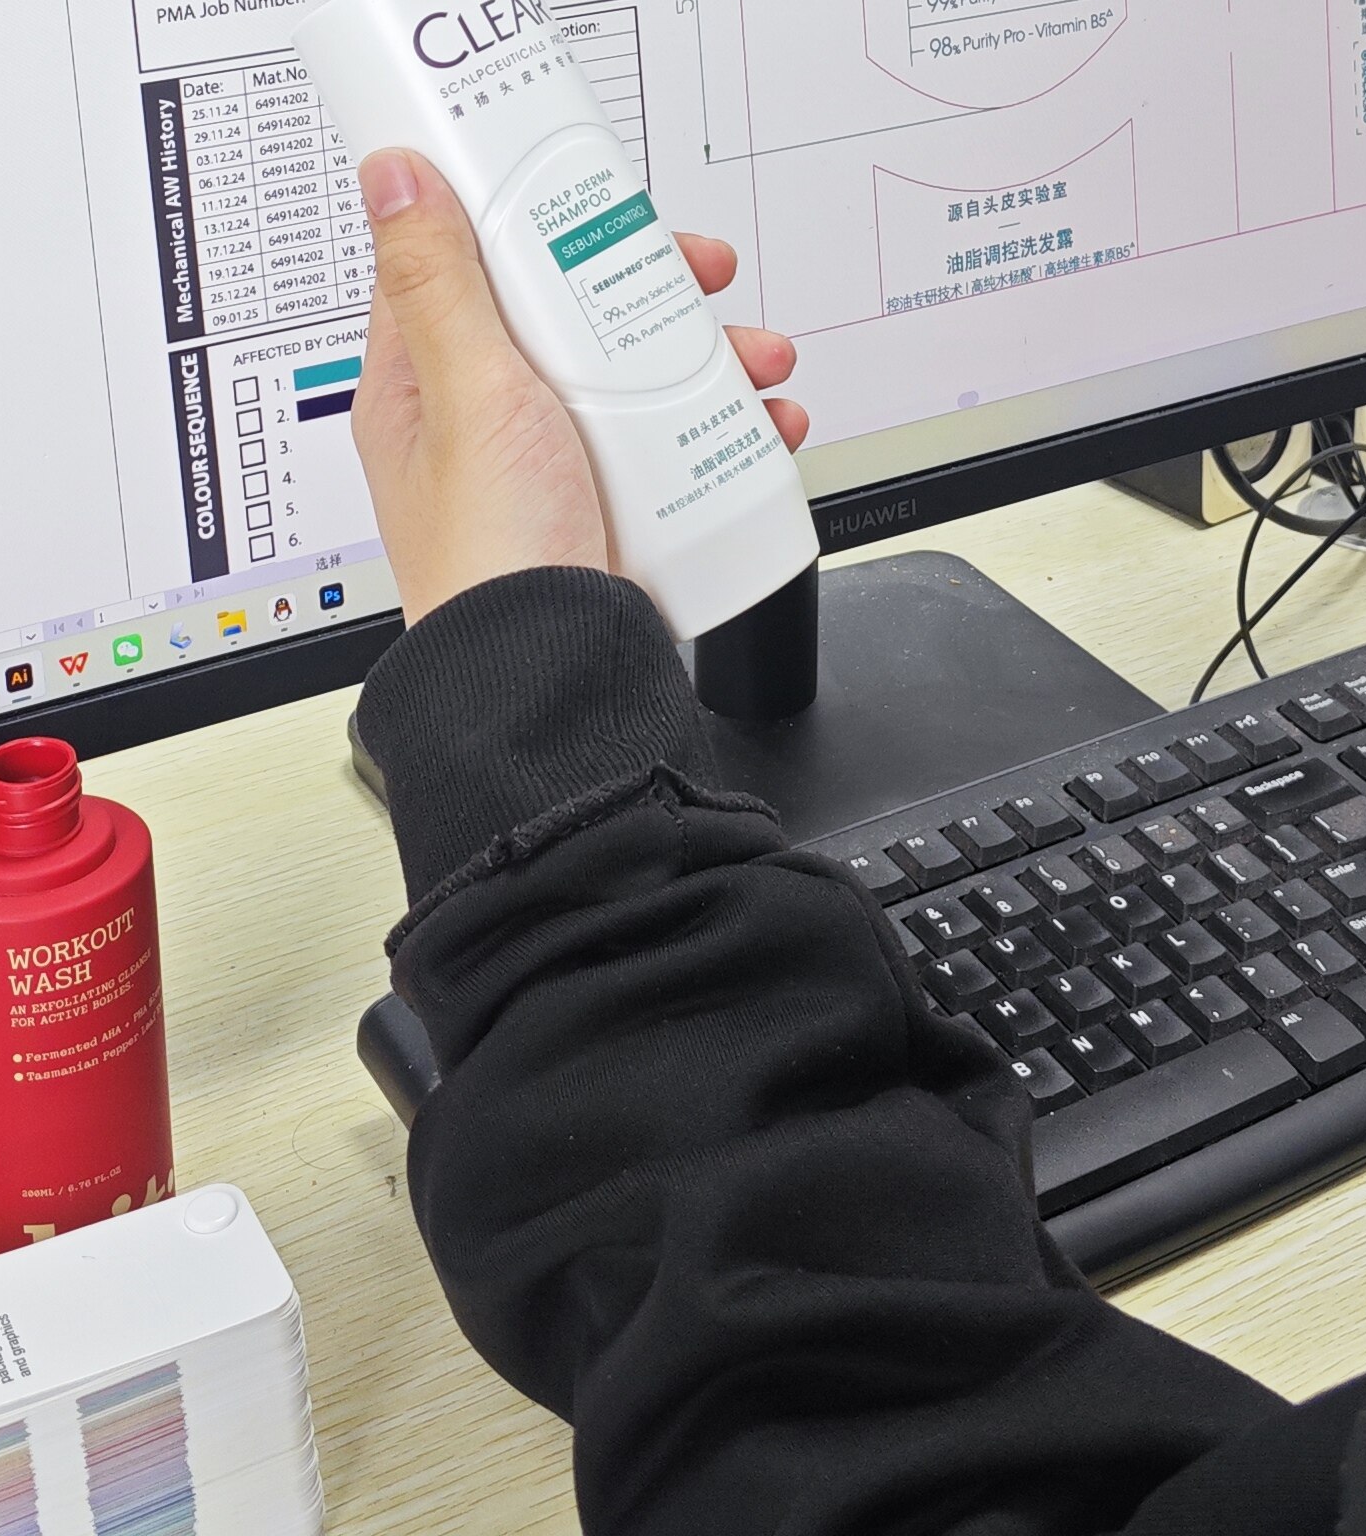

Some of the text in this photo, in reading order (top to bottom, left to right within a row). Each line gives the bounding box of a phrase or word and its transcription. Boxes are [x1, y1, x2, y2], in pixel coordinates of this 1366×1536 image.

[156, 3, 197, 25] PMA
[200, 0, 230, 19] Job
[963, 15, 1087, 52] Purity Vitamin
[439, 40, 547, 100] SCALPCEUTICALS
[183, 81, 225, 99] Date:
[255, 91, 310, 110] 64914202
[191, 103, 239, 121] 25.11.24
[198, 172, 246, 190] 06.12.24
[262, 159, 316, 179] 64914202
[528, 167, 615, 222] SCALP DERMA
[947, 180, 1068, 223] 源自头皮实验室
[158, 98, 194, 324] Mechanical AW History
[536, 187, 612, 237] SHAMPOO
[268, 227, 322, 247] 64914202
[560, 202, 649, 260] SEBUM CONTROL
[206, 240, 253, 259] 17.12.24
[946, 227, 1074, 275] 油脂调控洗发露
[212, 308, 260, 327] 09.01.25
[275, 294, 329, 314] 64914202
[233, 338, 323, 366] AFFECTED BY
[180, 352, 216, 540] COLOUR SEQUENCE
[828, 498, 918, 538] HUAWEI
[324, 590, 341, 604] Ps
[11, 669, 28, 686] Ai
[1243, 768, 1305, 797] Backspace
[1324, 861, 1357, 879] Enter
[6, 907, 136, 971] WORKOUT
[8, 959, 93, 997] WASH
[9, 1004, 27, 1016] AN
[31, 978, 116, 1015] EXFOLIATING
[10, 981, 135, 1029] FOR ACTIVE BODIES.
[1280, 1012, 1303, 1028] Alt
[25, 1034, 99, 1064] Fermented
[26, 1057, 100, 1082] Tasmanian
